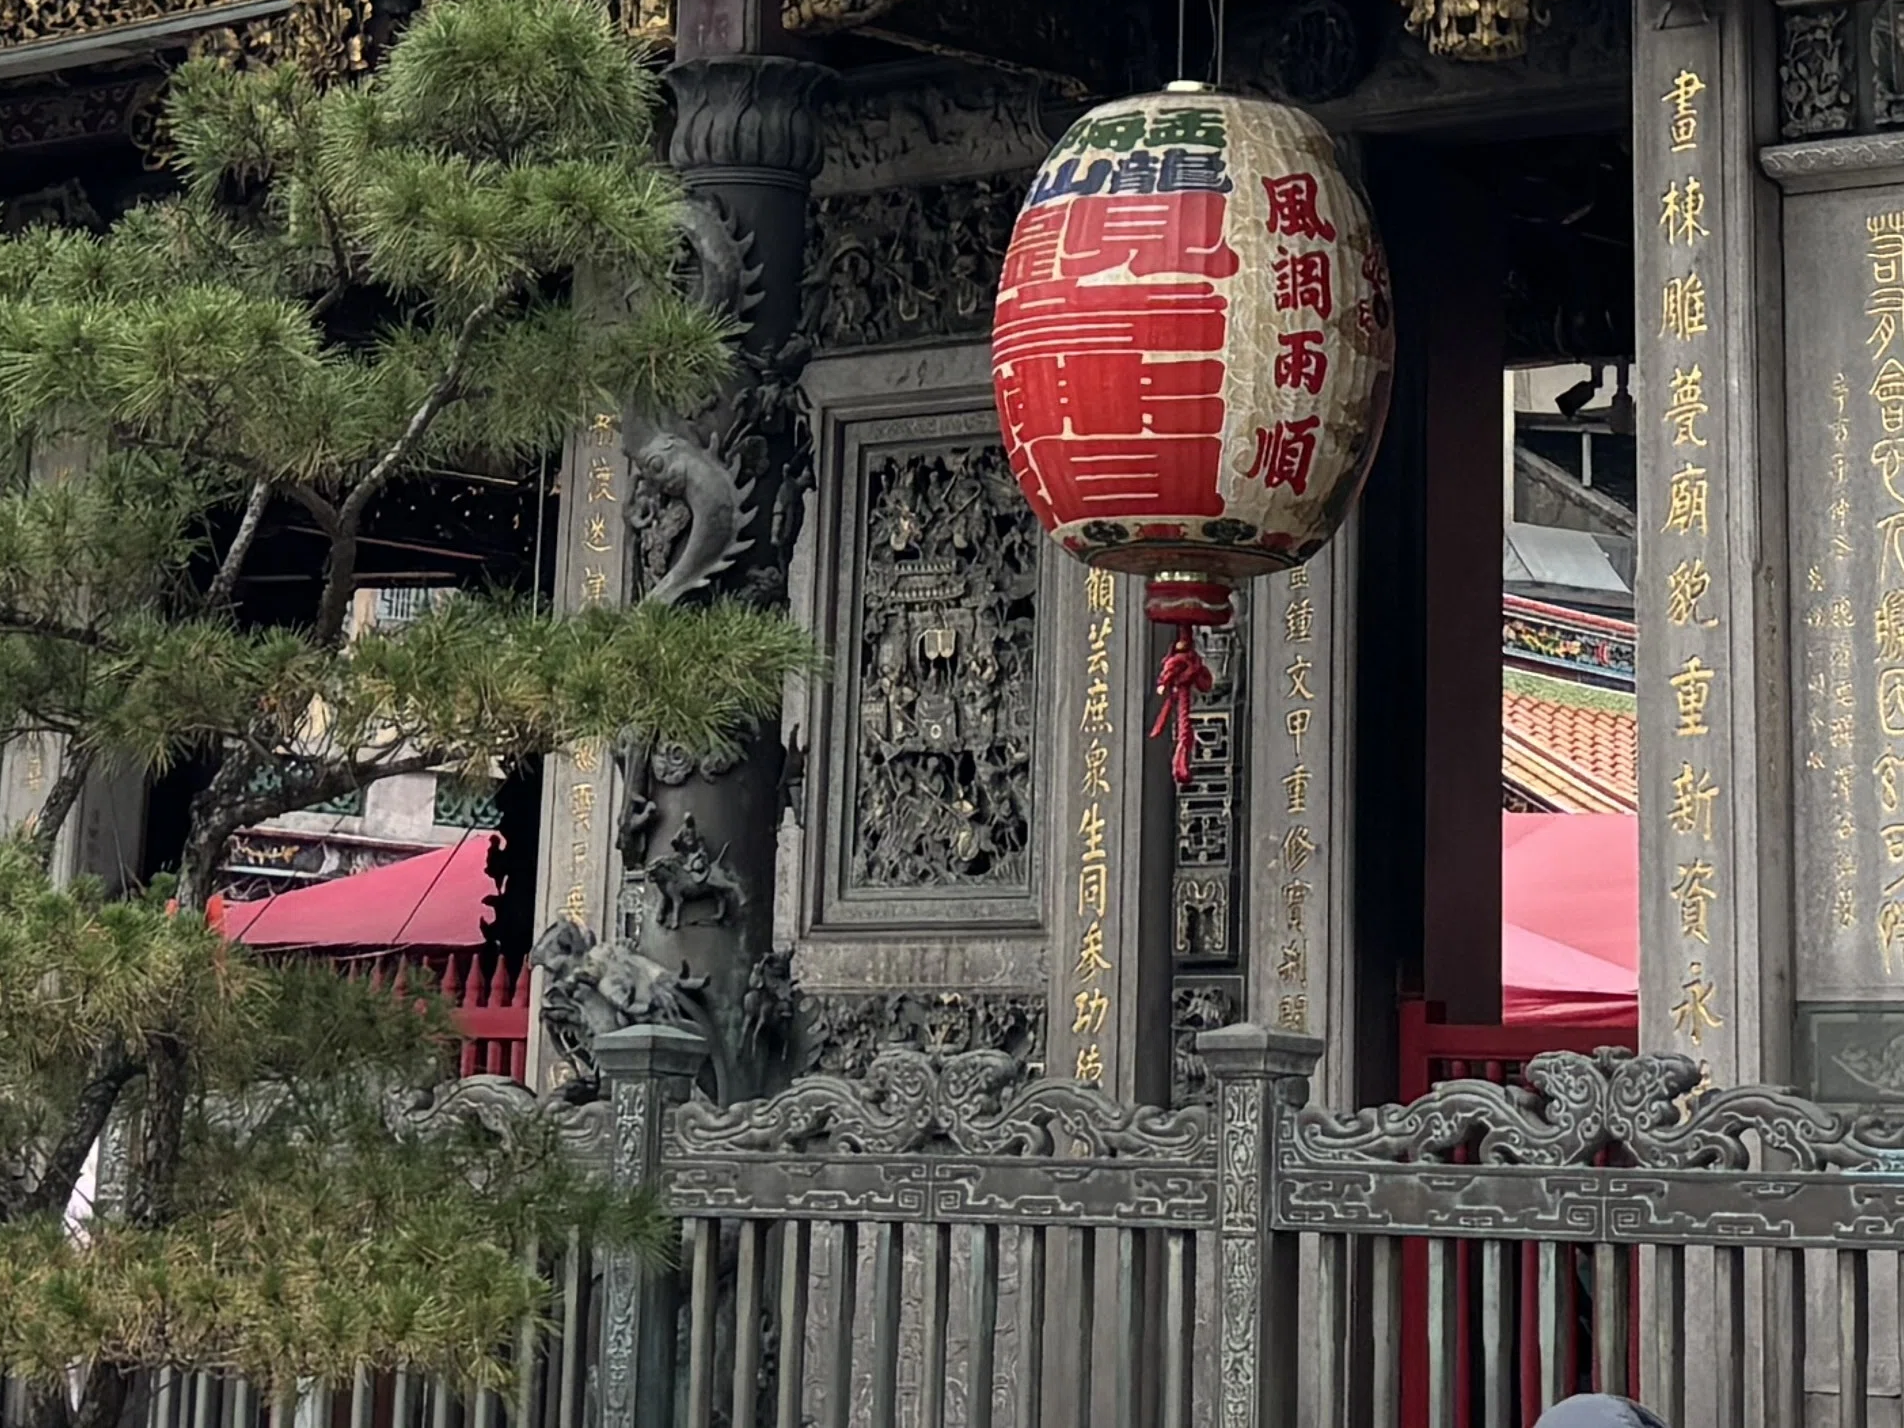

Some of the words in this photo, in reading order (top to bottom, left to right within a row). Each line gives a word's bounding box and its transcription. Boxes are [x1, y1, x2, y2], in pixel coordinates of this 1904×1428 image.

[1028, 149, 1234, 206] 龍山
[1248, 172, 1336, 495] 風調雨順
